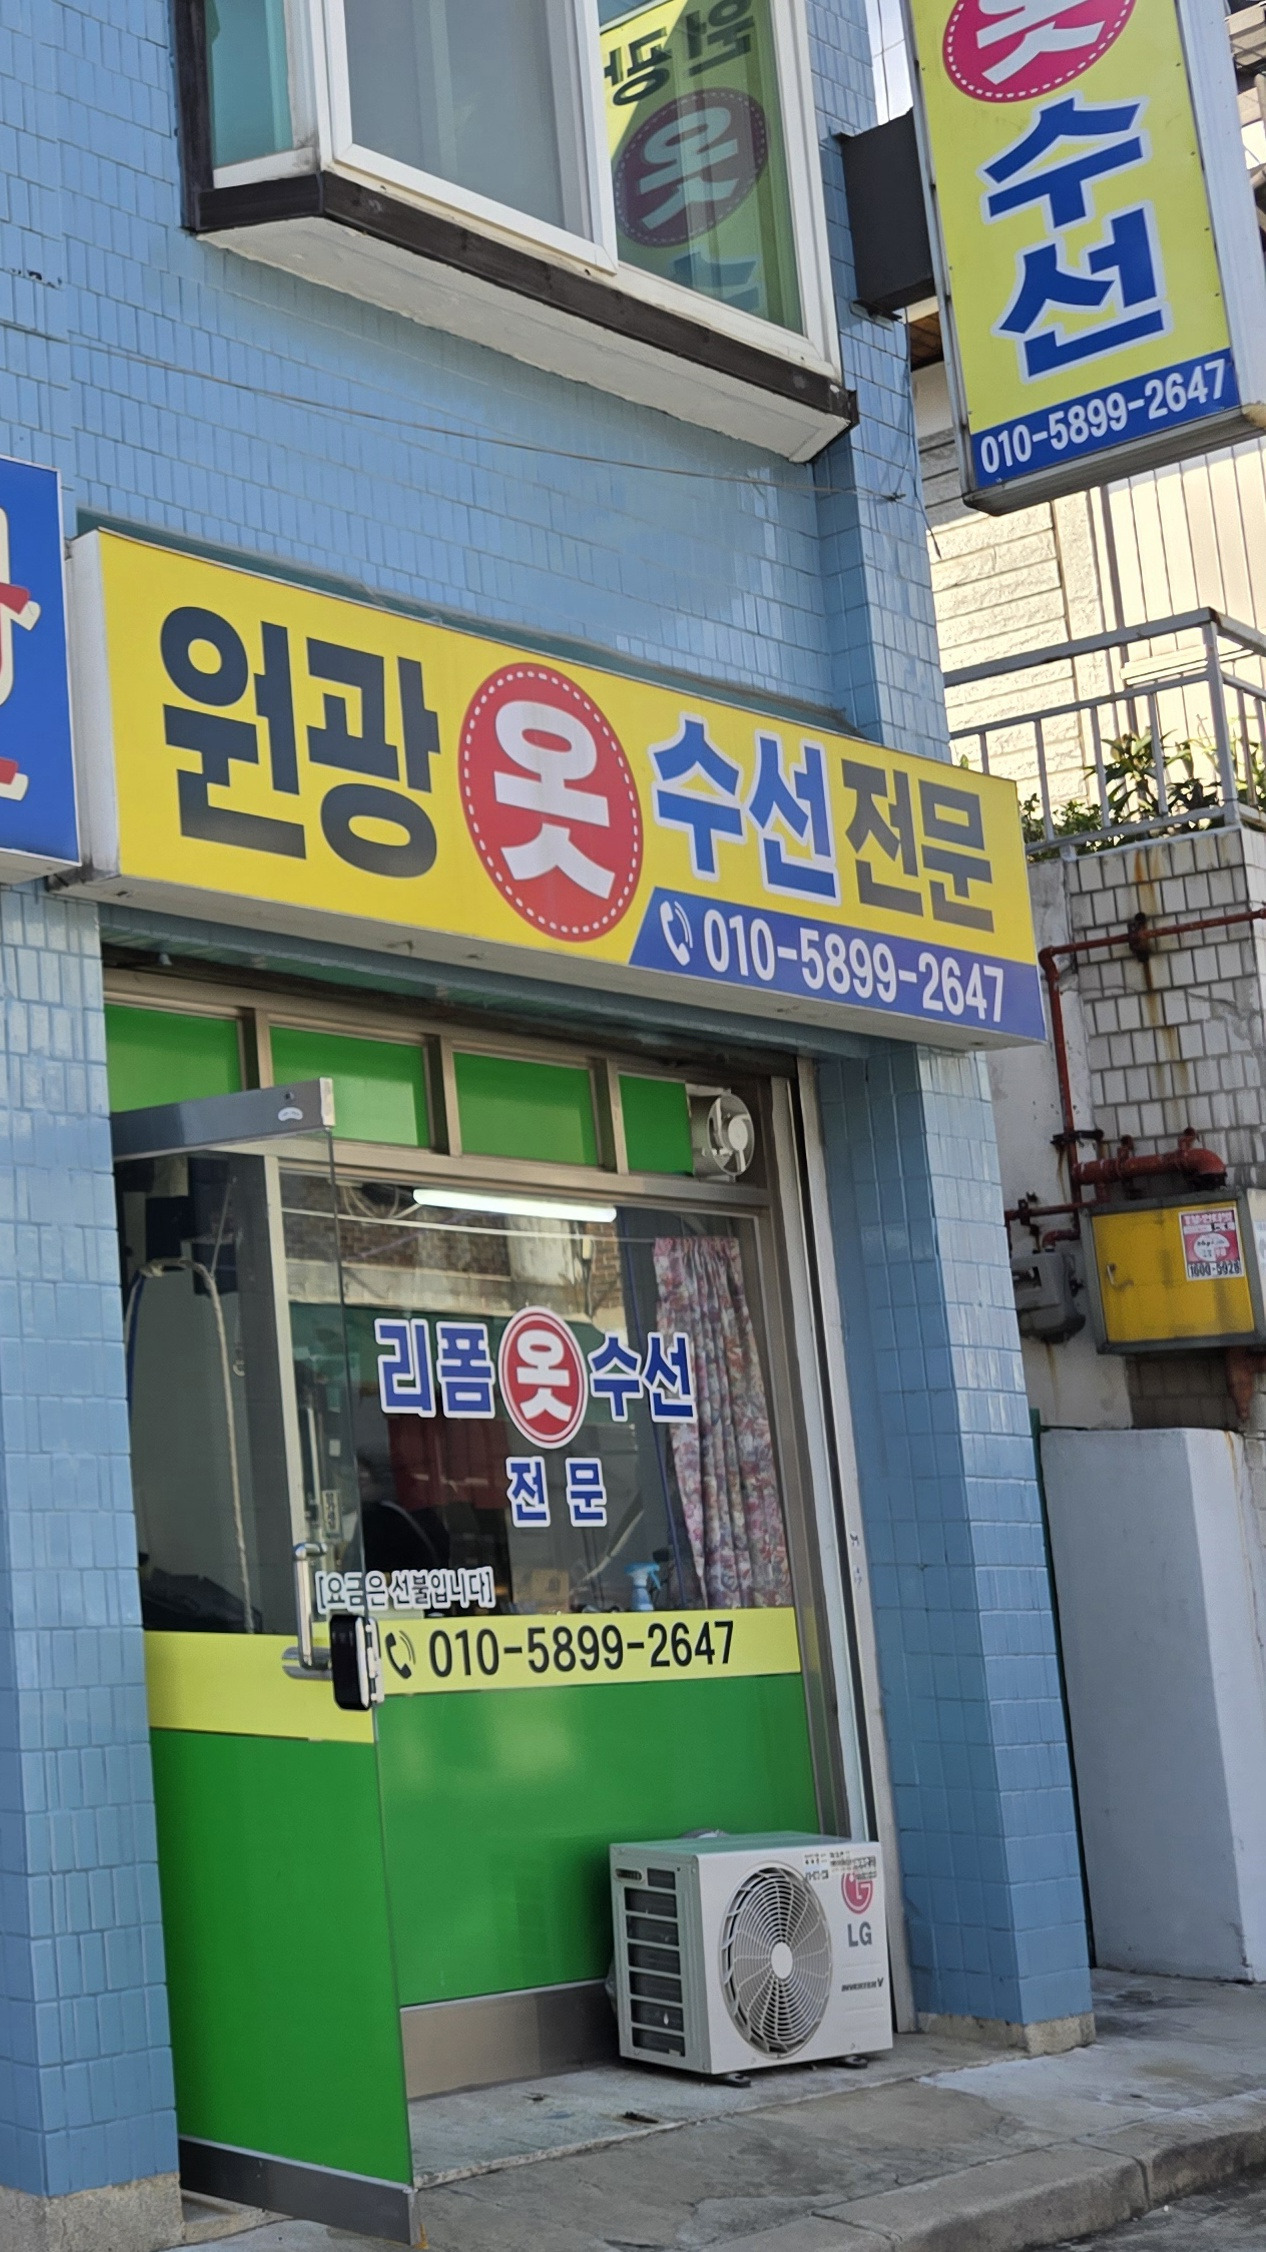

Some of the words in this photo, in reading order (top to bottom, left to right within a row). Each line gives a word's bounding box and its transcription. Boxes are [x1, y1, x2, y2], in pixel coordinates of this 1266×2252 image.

[981, 95, 1167, 380] 수선
[980, 359, 1226, 473] 010-5899-2647
[160, 606, 440, 878] 원광
[493, 701, 615, 899] 옷
[704, 909, 1004, 1022] 010-5899-2647
[376, 1320, 495, 1418] 리폼
[516, 1329, 572, 1422] 옷
[589, 1333, 697, 1421] 수선
[389, 1566, 495, 1611] 선불입니다]
[429, 1621, 734, 1677] 010-5899-2647
[847, 1922, 872, 1948] LG
